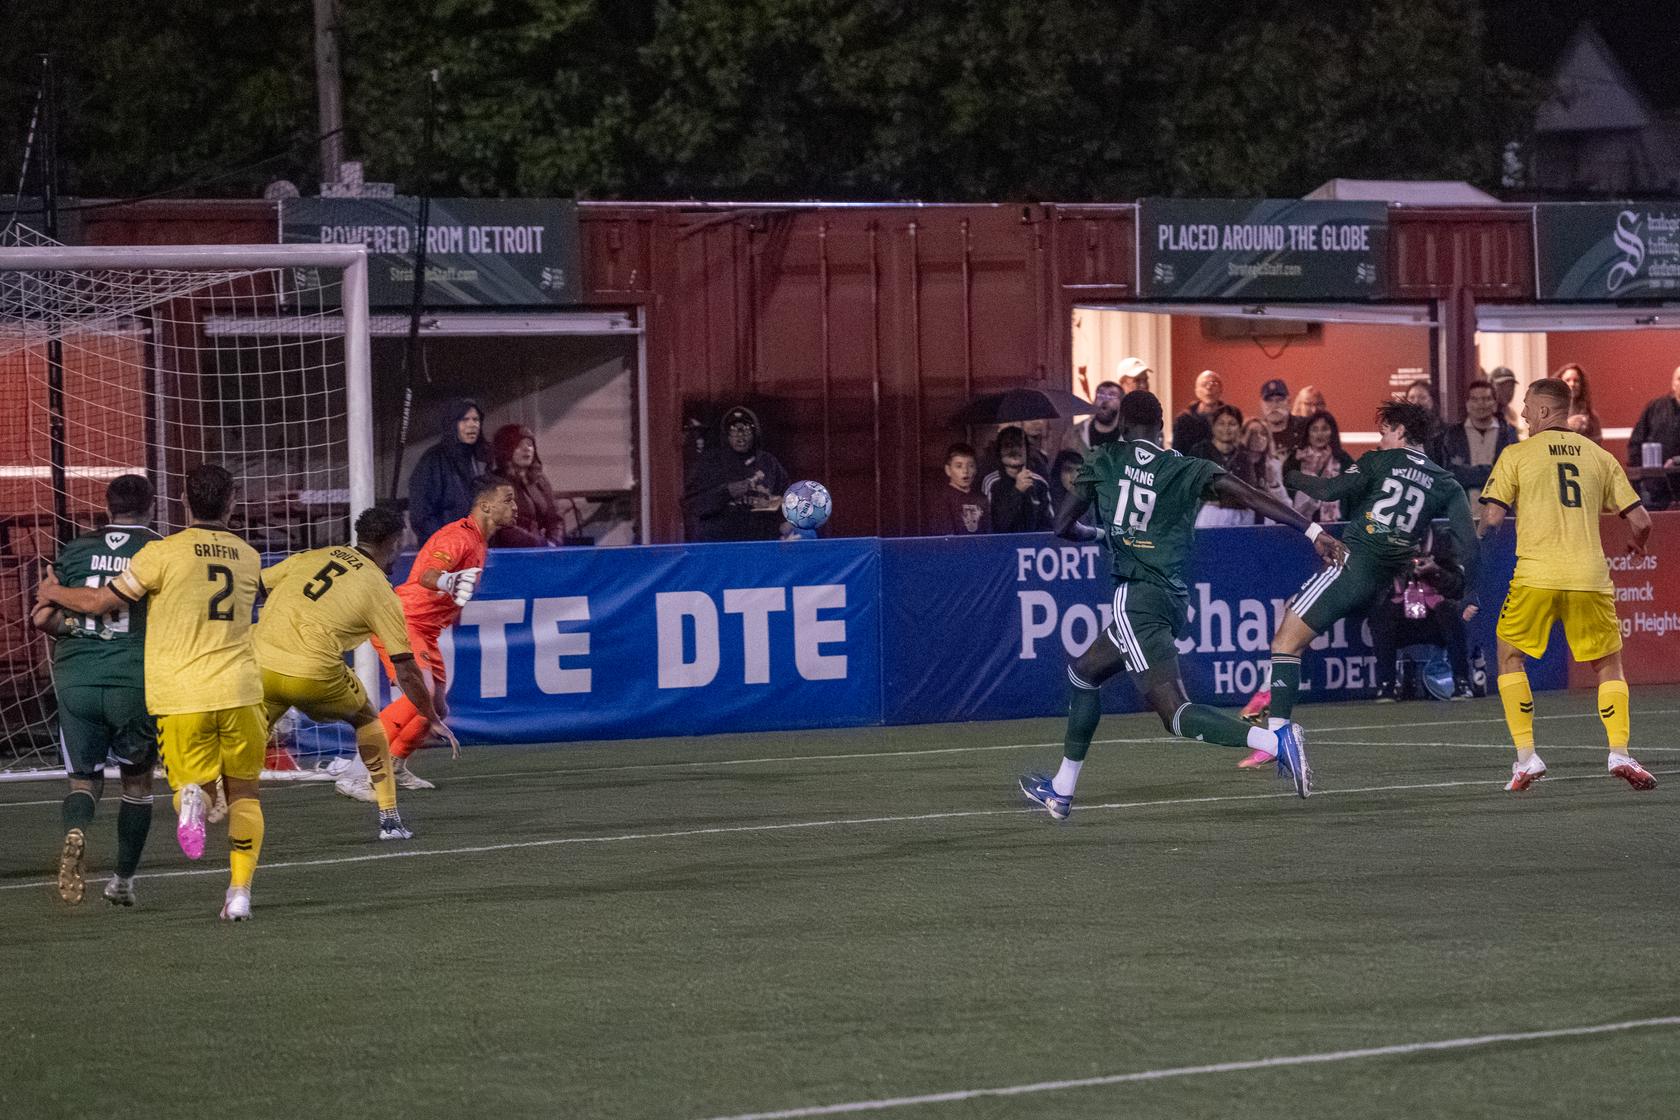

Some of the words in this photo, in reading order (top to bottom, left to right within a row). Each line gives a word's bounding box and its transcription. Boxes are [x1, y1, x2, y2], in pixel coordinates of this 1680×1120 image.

[320, 225, 409, 254] POWERED
[468, 225, 544, 254] DETROIT
[1158, 224, 1218, 251] PLACED
[1221, 224, 1284, 251] AROUND
[1288, 225, 1317, 251] THE
[1321, 225, 1370, 251] GLOBE
[1548, 444, 1581, 456] MIKOY
[1124, 465, 1155, 487] NIANG
[1557, 461, 1582, 508] 6
[1113, 478, 1157, 532] 19
[1371, 477, 1425, 534] 23
[90, 554, 131, 572] DALOU
[194, 543, 240, 560] GRIFFIN
[329, 549, 364, 571] SOUZA
[1016, 546, 1100, 581] FORT
[207, 563, 235, 622] 2
[303, 560, 349, 602] 5
[655, 583, 848, 689] DTE
